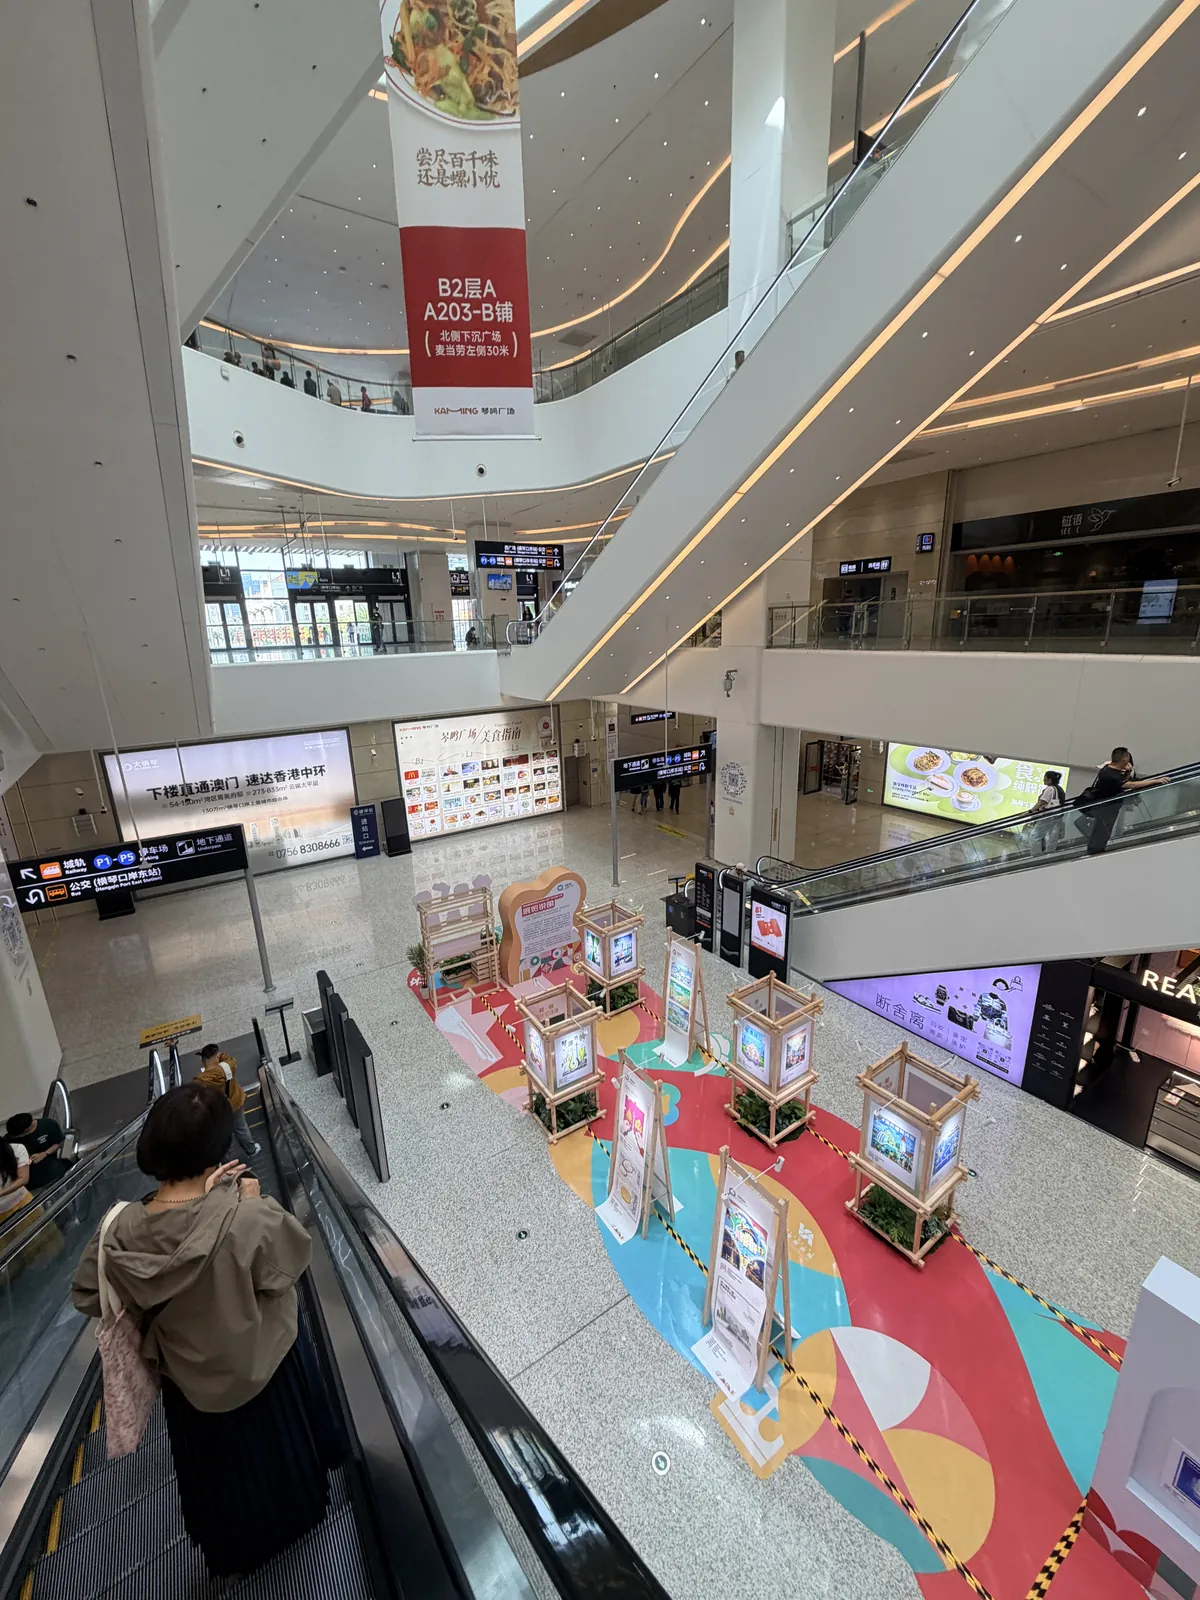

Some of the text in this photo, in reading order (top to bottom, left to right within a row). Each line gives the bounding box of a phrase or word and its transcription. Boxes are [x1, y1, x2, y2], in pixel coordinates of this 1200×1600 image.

[416, 147, 499, 169] 尝尽百千味
[437, 277, 497, 299] B2层A
[424, 302, 513, 323] A203-B铺
[219, 568, 231, 577] L1
[391, 571, 400, 579] L1
[146, 765, 326, 801] 下楼直通澳门 速达香港中环
[63, 857, 86, 869] 城轨
[196, 833, 233, 847] 地下通道
[300, 838, 341, 854] 8308666
[65, 867, 87, 875] Railway
[69, 880, 92, 891] 公交
[876, 993, 925, 1030] 断舍离
